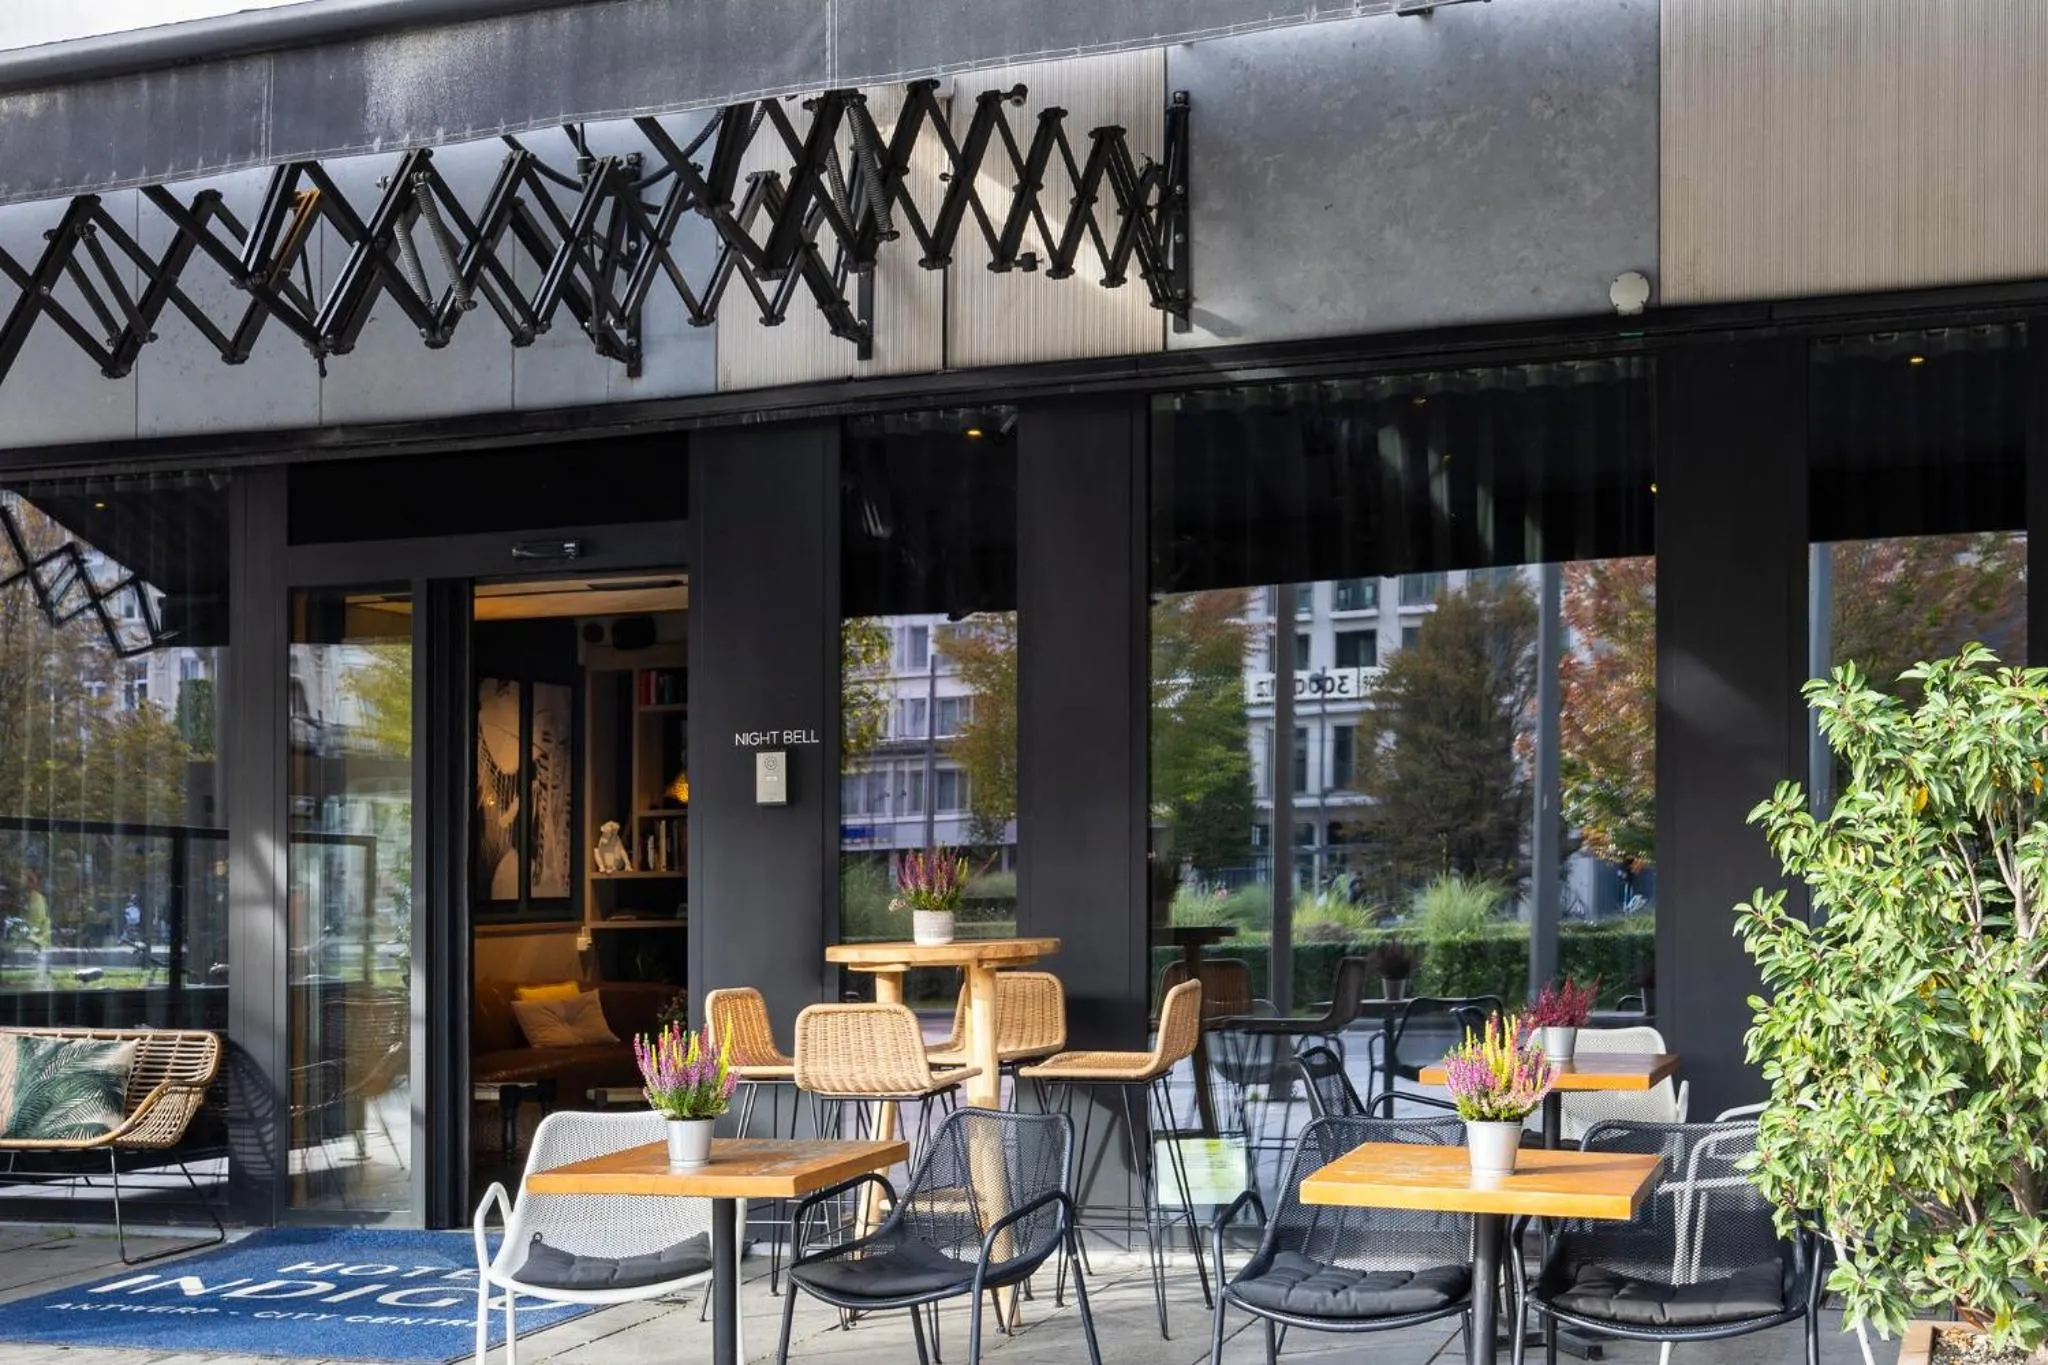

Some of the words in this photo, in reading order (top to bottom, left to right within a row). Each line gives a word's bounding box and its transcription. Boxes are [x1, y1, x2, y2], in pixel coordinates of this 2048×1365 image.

[735, 731, 780, 746] NIGHT
[783, 729, 819, 744] BELL
[277, 1261, 480, 1280] HOTE
[45, 1303, 219, 1314] ANTWERP
[253, 1310, 342, 1321] CITY
